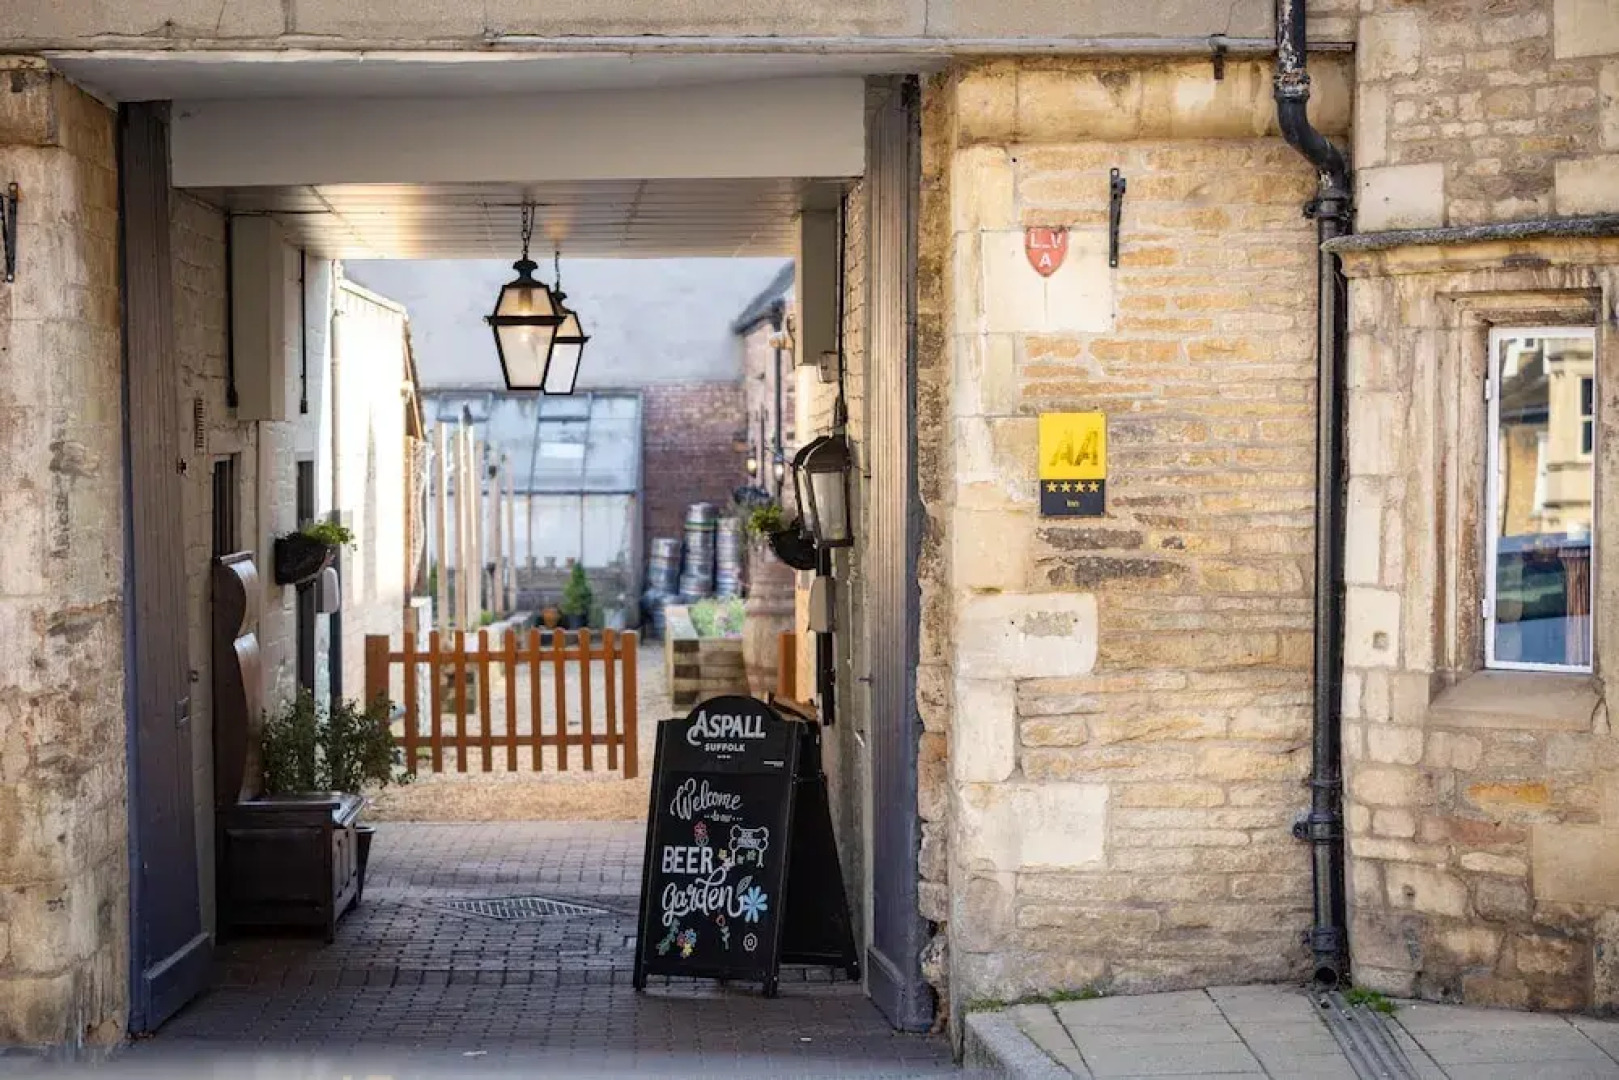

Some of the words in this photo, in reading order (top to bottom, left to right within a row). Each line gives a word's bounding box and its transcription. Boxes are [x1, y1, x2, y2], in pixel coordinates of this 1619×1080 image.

[1049, 428, 1099, 467] AA
[686, 710, 767, 746] ASPALL
[704, 742, 746, 752] SUFFOLK
[670, 778, 744, 820] Welcome
[662, 845, 714, 874] BEER
[661, 866, 746, 927] garden
